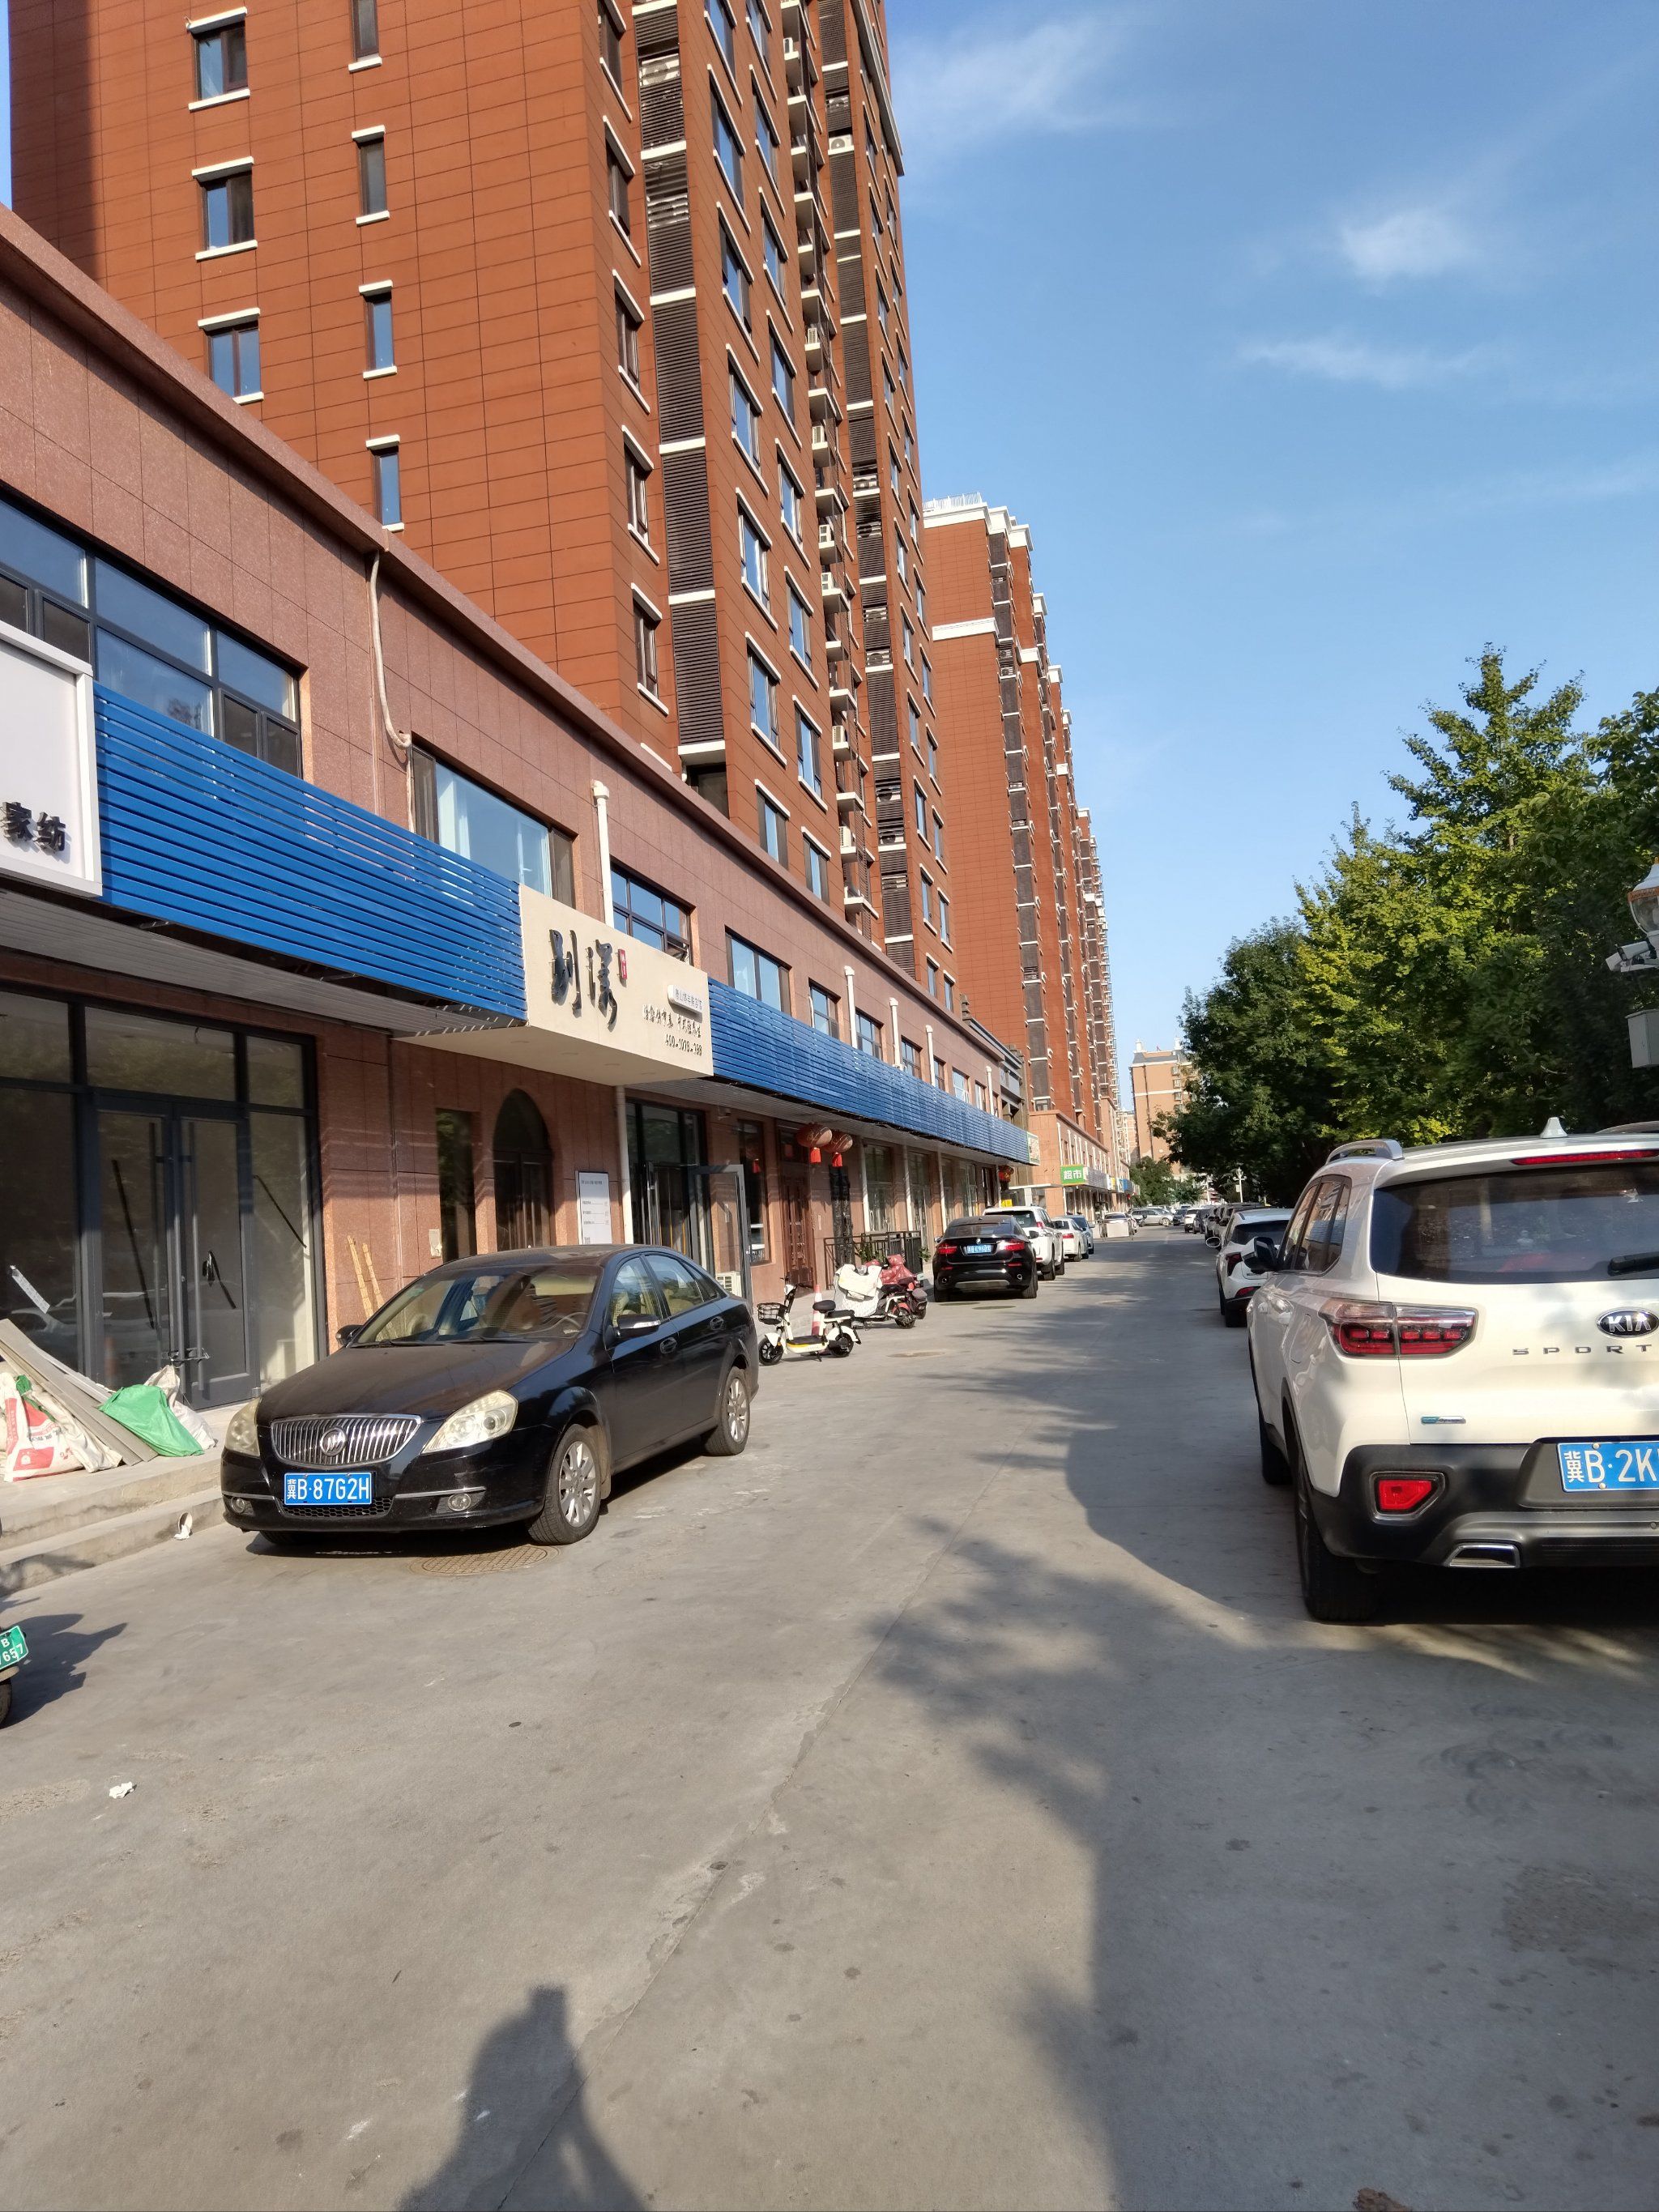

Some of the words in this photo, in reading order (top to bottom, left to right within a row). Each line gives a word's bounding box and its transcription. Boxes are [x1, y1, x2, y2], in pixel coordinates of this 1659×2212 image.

[2, 802, 66, 853] 家纺
[1063, 1169, 1082, 1180] 超市
[1607, 1312, 1652, 1332] KIA
[1512, 1344, 1653, 1356] SPORT
[1563, 1448, 1659, 1483] 冀B·2K
[287, 1477, 369, 1500] 冀B·87G2H
[0, 1643, 23, 1664] 657
